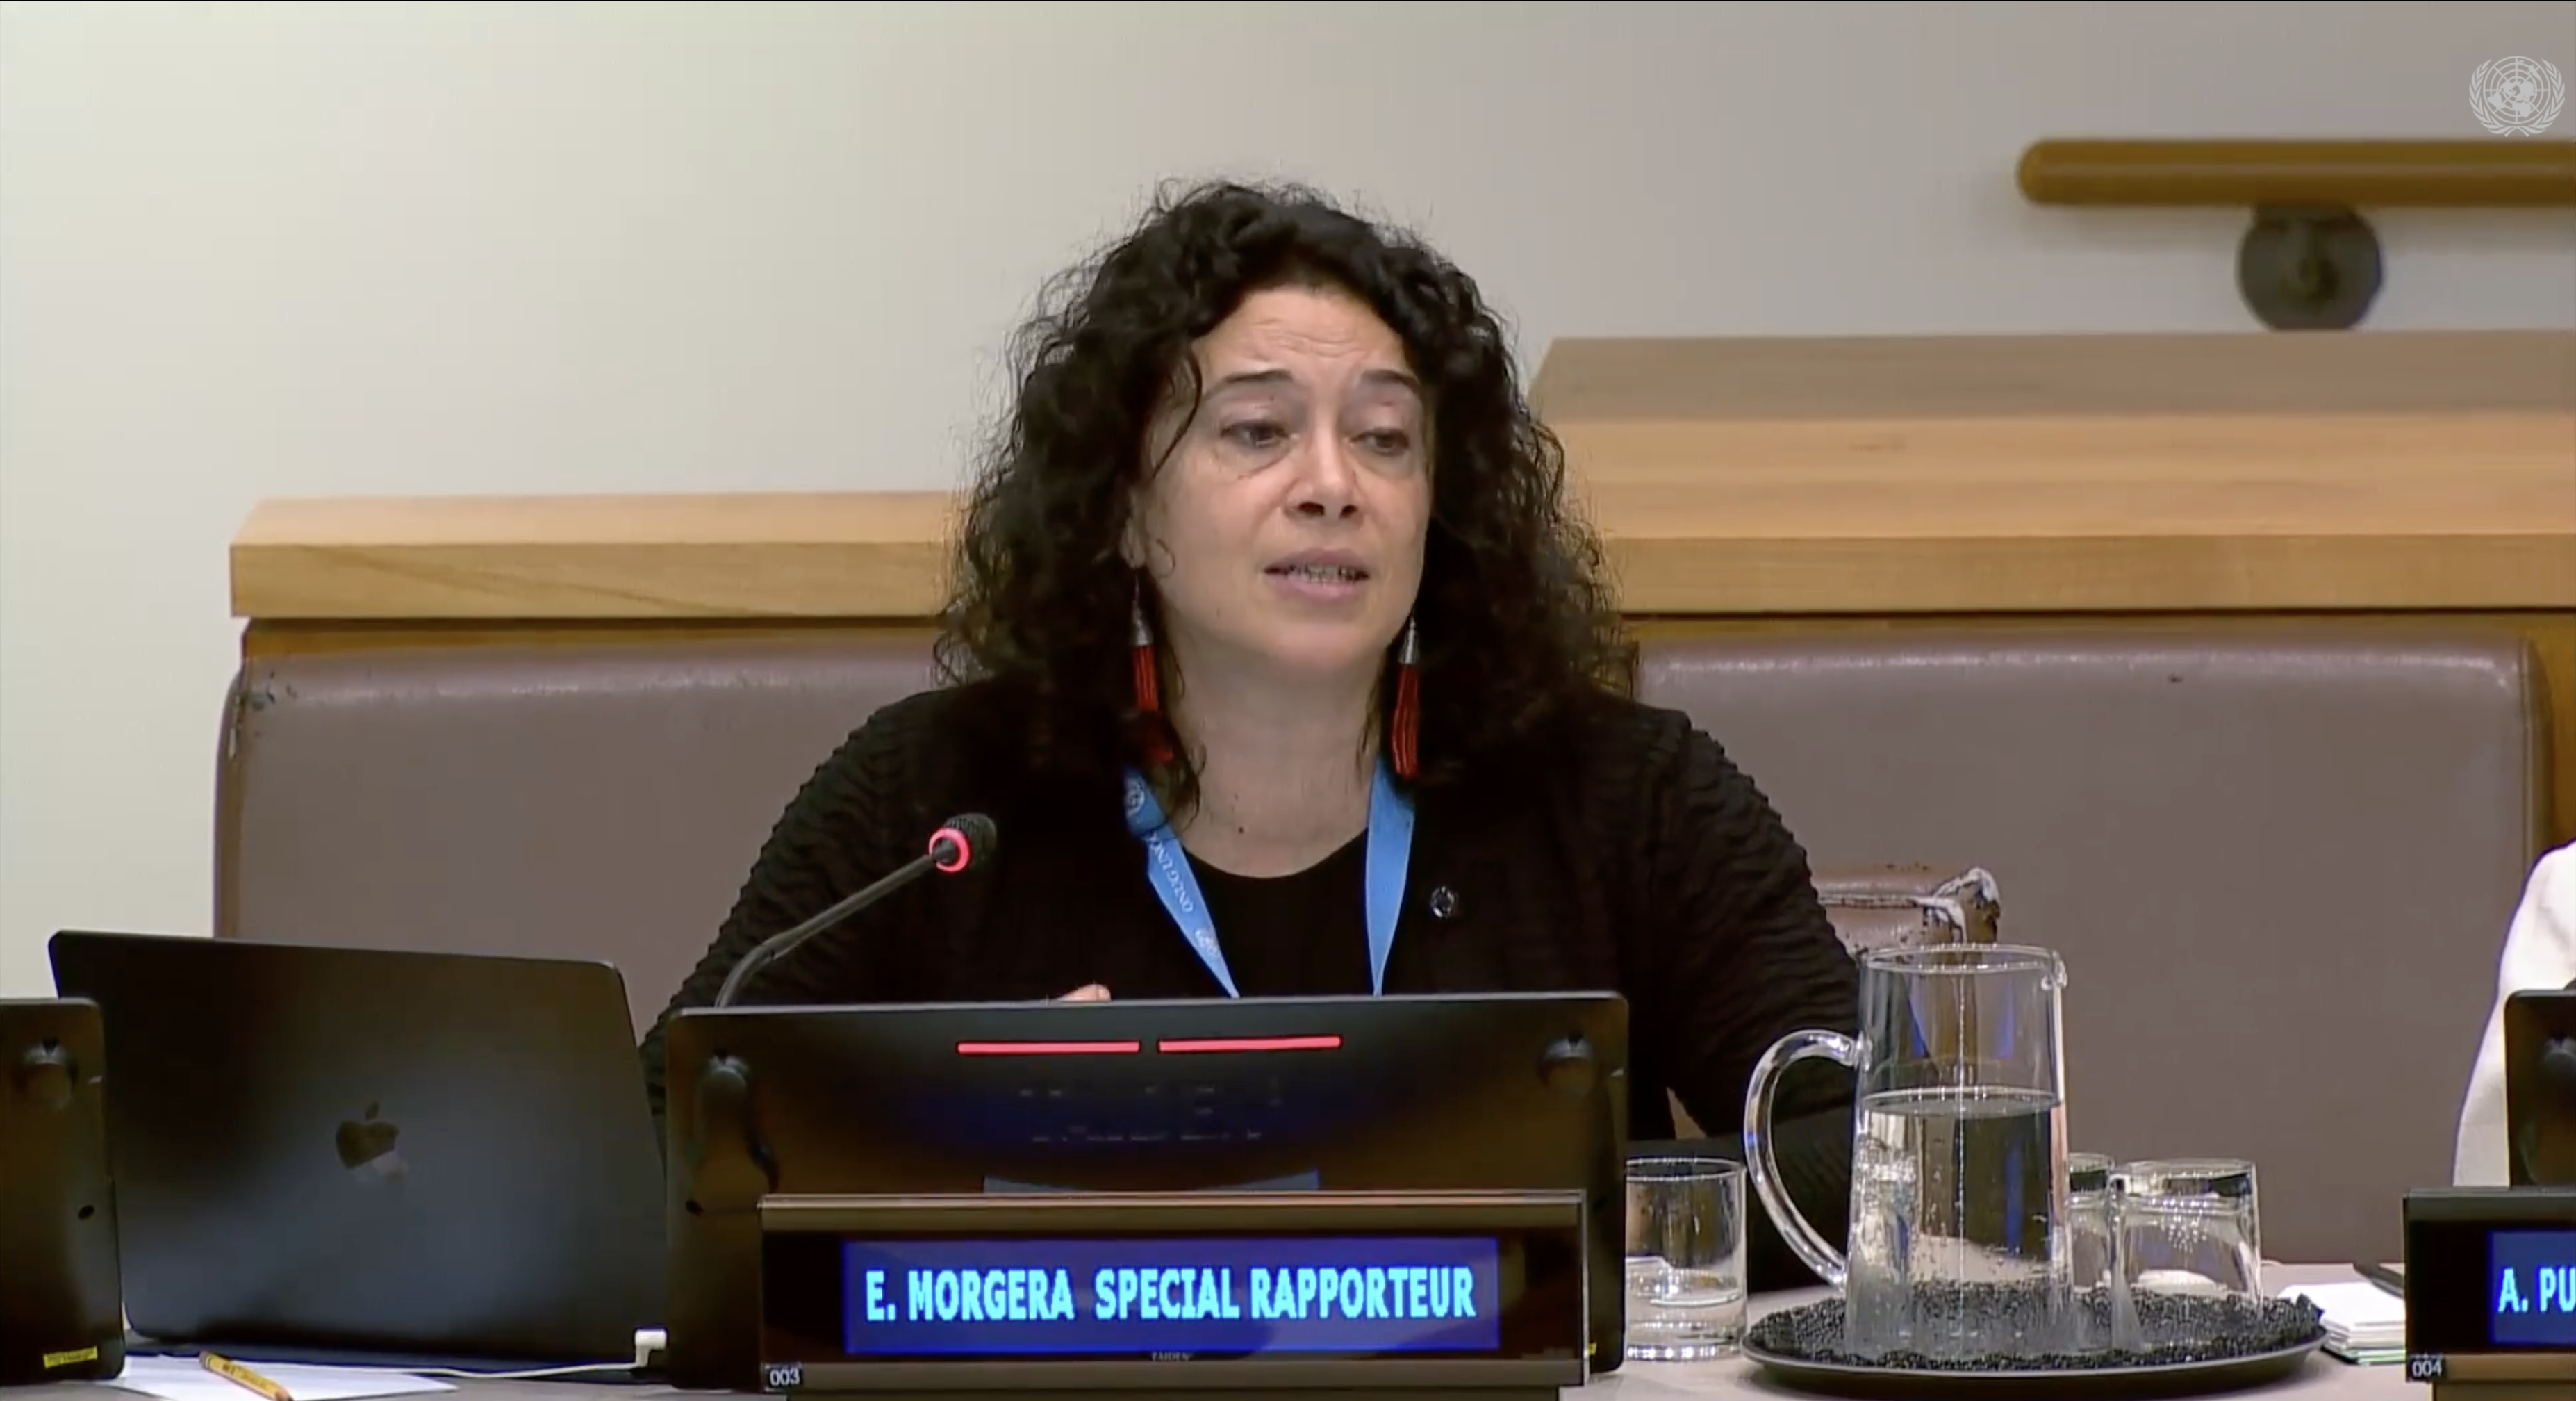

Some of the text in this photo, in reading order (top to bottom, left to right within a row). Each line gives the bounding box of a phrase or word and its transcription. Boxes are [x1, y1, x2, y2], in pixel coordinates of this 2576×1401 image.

[866, 1267, 1476, 1321] E. MORGERA SPECIAL RAPPORTEUR
[2498, 1268, 2529, 1312] A.
[770, 1368, 800, 1386] 003
[2411, 1360, 2443, 1377] 004
